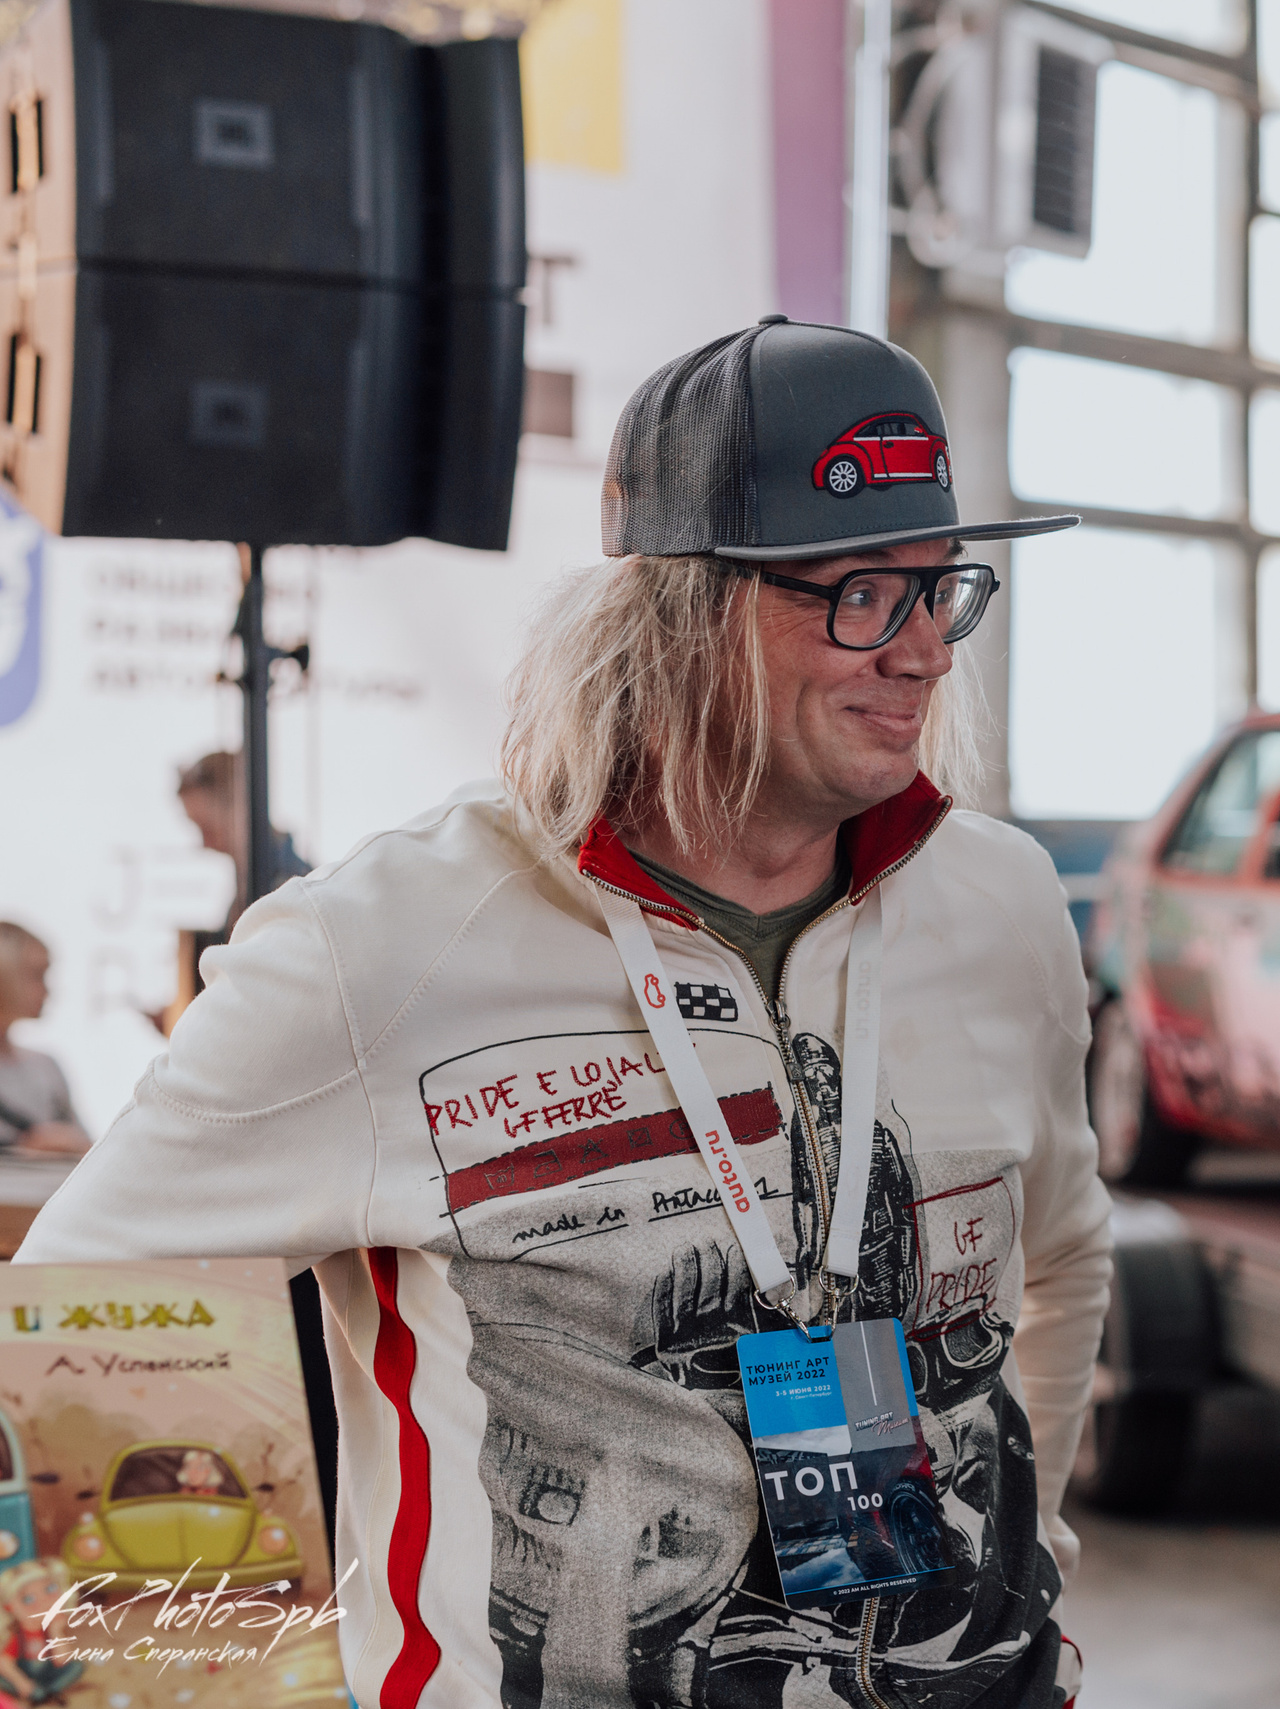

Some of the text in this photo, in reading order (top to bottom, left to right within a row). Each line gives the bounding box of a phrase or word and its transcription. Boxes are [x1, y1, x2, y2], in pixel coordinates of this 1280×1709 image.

[424, 1074, 520, 1136] PRIDE
[536, 1069, 558, 1096] E
[704, 1130, 751, 1214] auto.ru
[511, 1213, 586, 1244] made
[925, 1257, 998, 1314] PRIDE
[746, 1356, 830, 1375] ТЮНИНГ АРТ
[748, 1368, 826, 1386] МУЗЕЙ 2022
[789, 1386, 812, 1396] ИЮНЯ
[814, 1384, 831, 1392] 2022
[764, 1461, 858, 1501] ТОП
[847, 1492, 884, 1511] 100
[870, 1582, 889, 1590] RIGHTS
[890, 1577, 917, 1586] RESERVED
